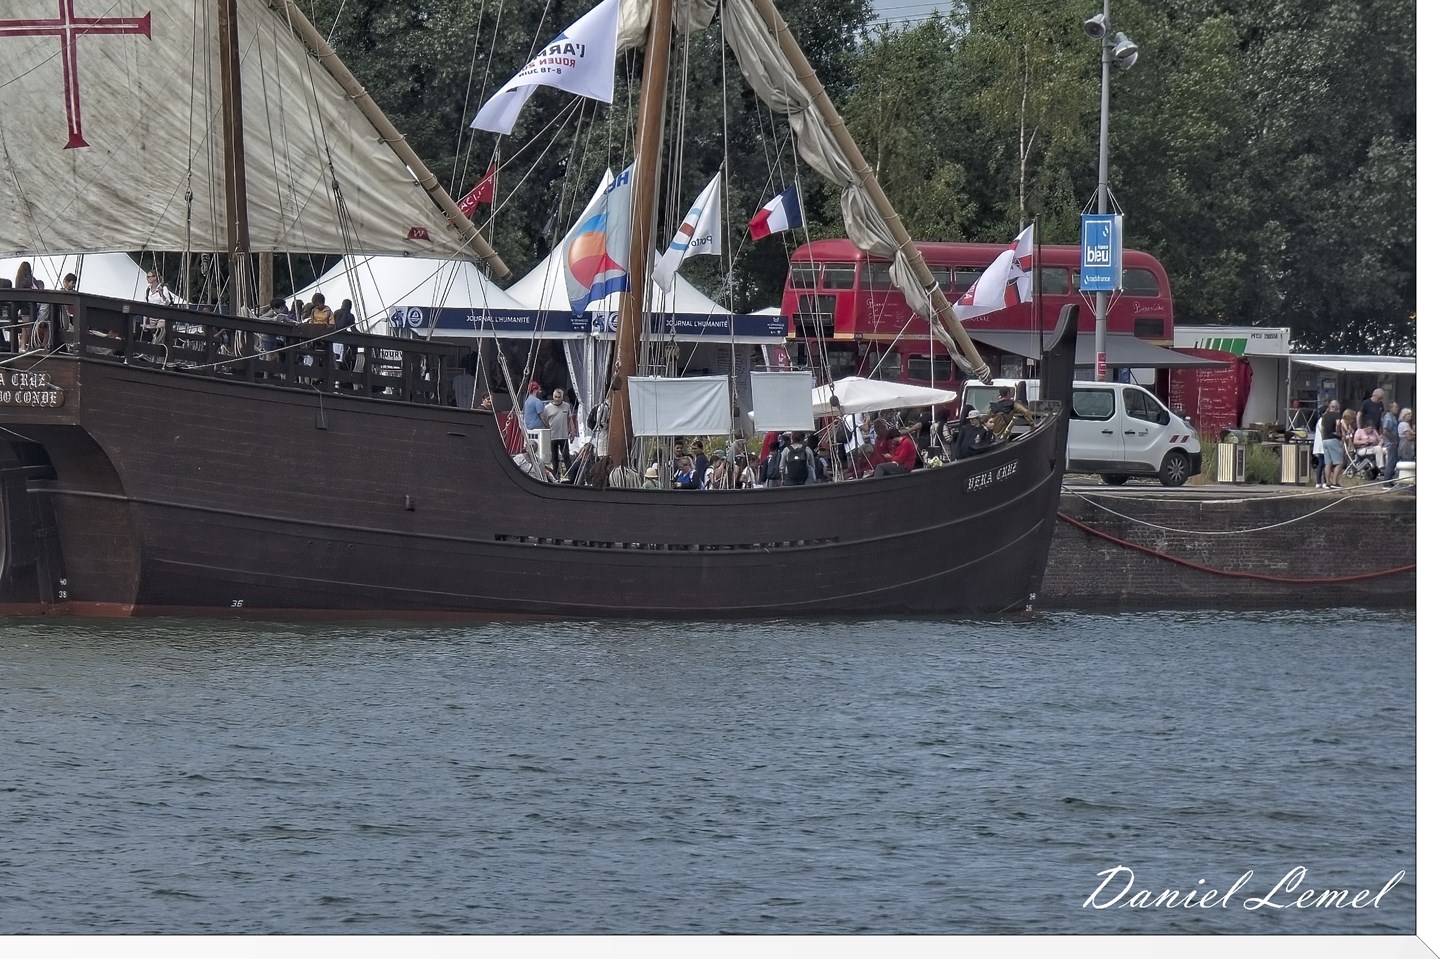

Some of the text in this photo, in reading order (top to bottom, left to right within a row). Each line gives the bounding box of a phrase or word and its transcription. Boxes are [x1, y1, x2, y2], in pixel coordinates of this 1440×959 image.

[1087, 246, 1109, 262] bleu
[466, 314, 530, 323] JOURNAL L'HUMANITÉ
[665, 319, 693, 327] JOURNAL
[14, 390, 58, 407] CONDE
[230, 599, 244, 608] 36
